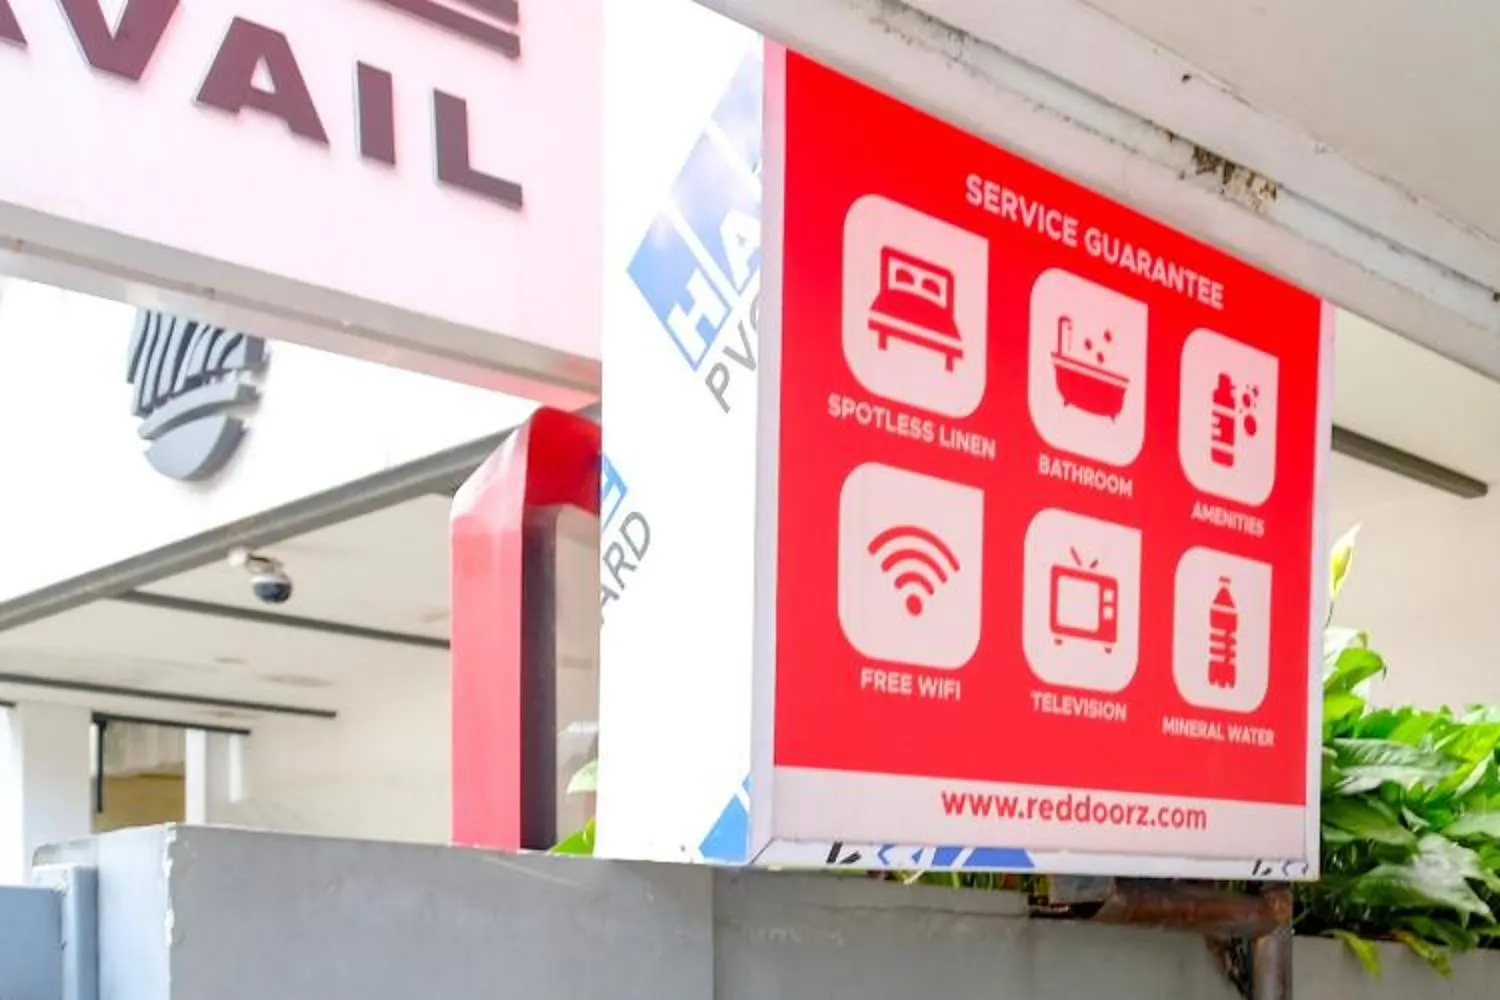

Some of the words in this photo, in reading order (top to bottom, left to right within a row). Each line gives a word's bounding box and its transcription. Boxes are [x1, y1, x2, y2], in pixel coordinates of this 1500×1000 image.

[0, 0, 524, 211] VAIL
[965, 173, 1079, 248] SERVICE
[1084, 226, 1225, 310] GUARANTEE
[827, 392, 936, 443] SPOTLESS
[938, 424, 997, 461] LINEN
[1038, 454, 1134, 498] BATHROOM
[1191, 500, 1265, 537] AMENITIES
[860, 668, 913, 696] FREE
[917, 673, 961, 701] WIFI
[1031, 690, 1127, 722] TELEVISION
[1161, 716, 1225, 741] MINERAL
[1226, 723, 1275, 747] WATER
[941, 790, 1208, 831] www.reddoorz.com
